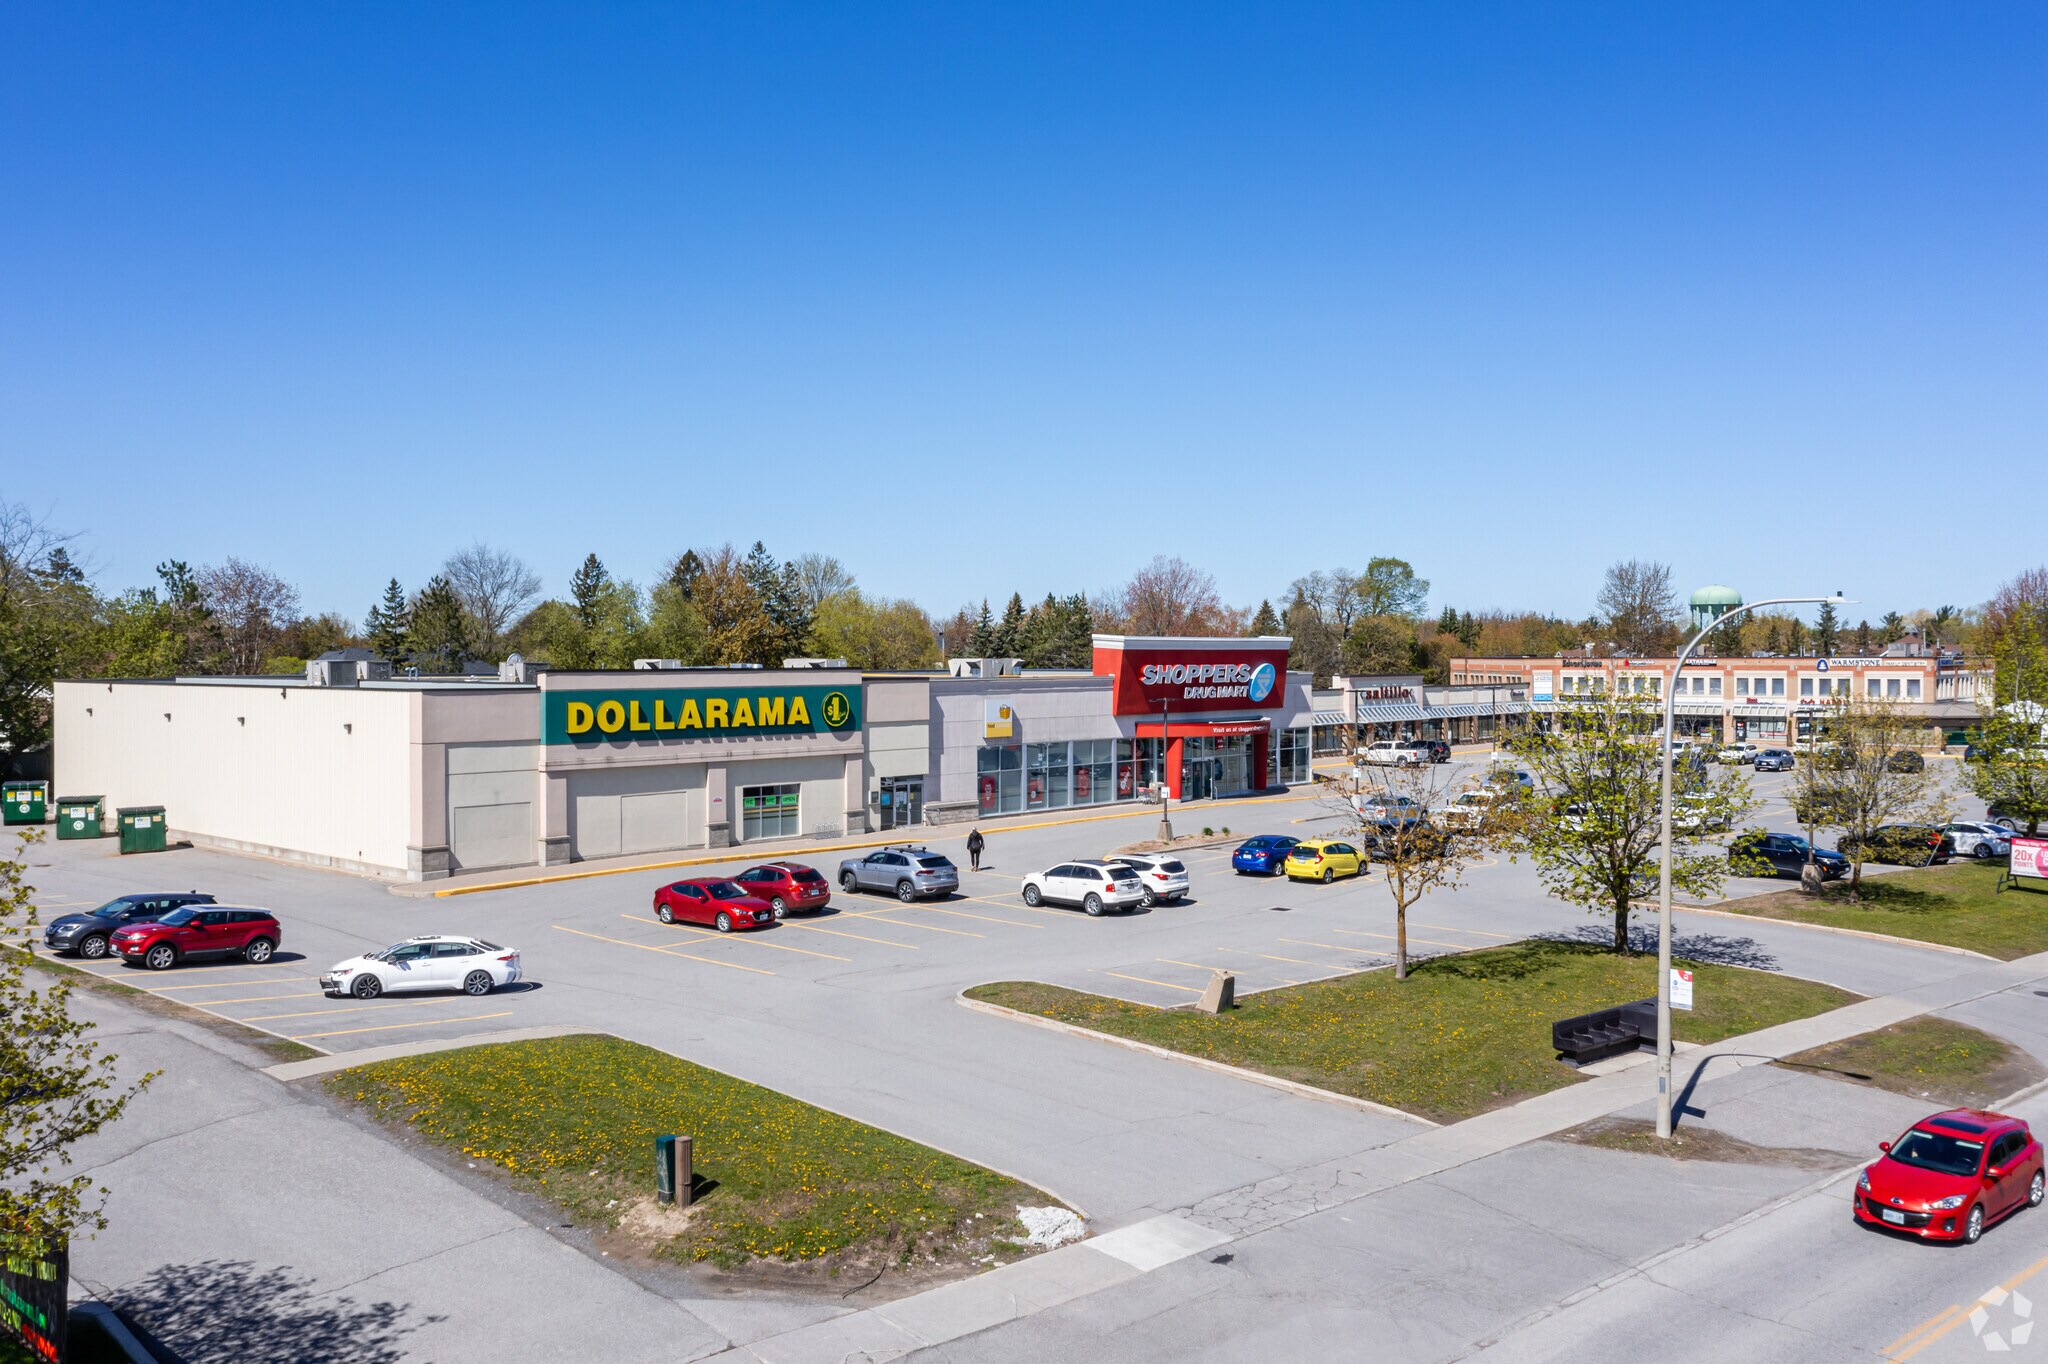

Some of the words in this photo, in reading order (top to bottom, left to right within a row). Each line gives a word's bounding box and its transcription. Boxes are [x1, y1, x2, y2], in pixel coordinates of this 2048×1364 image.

[1141, 664, 1251, 685] SHOPPERS
[1183, 686, 1217, 699] DRUG
[1217, 685, 1249, 698] MART
[1365, 686, 1409, 700] saltillo
[566, 696, 810, 734] DOLLARAMA
[2014, 849, 2033, 861] 20x
